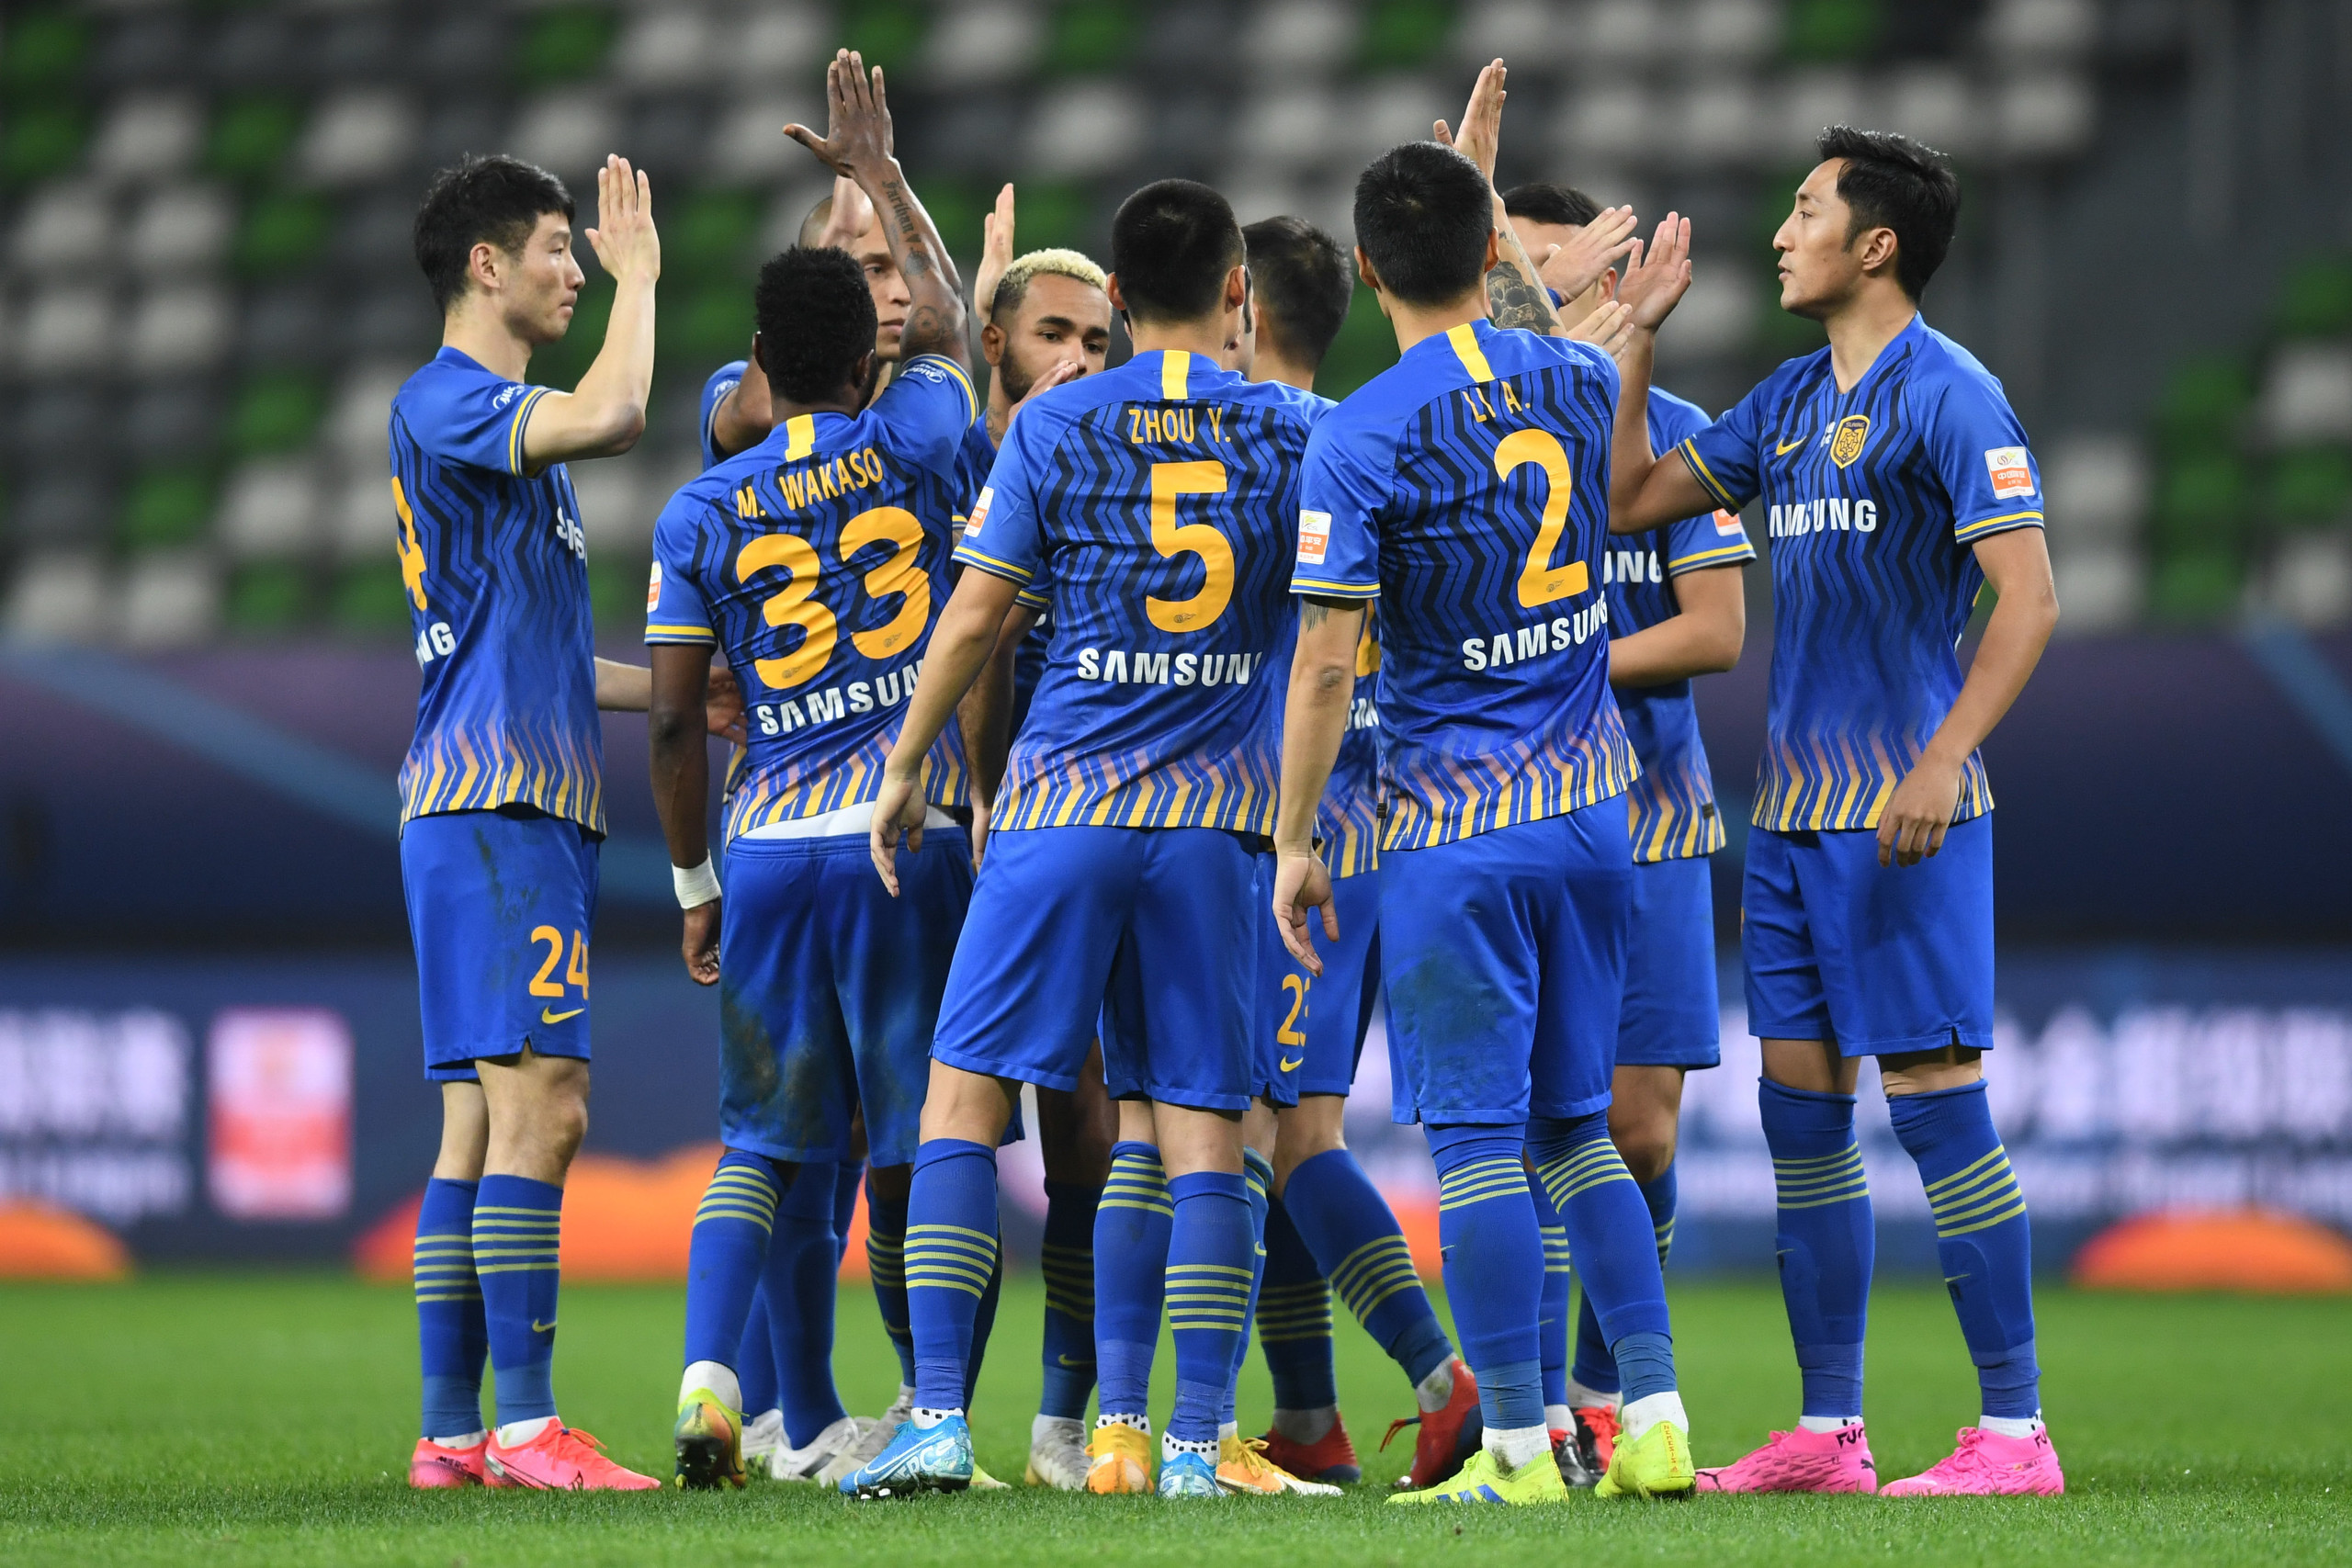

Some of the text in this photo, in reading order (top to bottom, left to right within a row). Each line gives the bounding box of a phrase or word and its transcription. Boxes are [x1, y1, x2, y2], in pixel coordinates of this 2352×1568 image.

[1128, 407, 1232, 445] ZHOU Y.
[1462, 380, 1532, 423] LI A.
[736, 446, 884, 521] M. WAKASO
[1493, 428, 1589, 609] 2
[1145, 459, 1236, 633] 5
[736, 505, 931, 690] 33
[1462, 590, 1609, 672] SAMSUNG
[1077, 647, 1263, 688] SAMSUN
[528, 924, 590, 1000] 24
